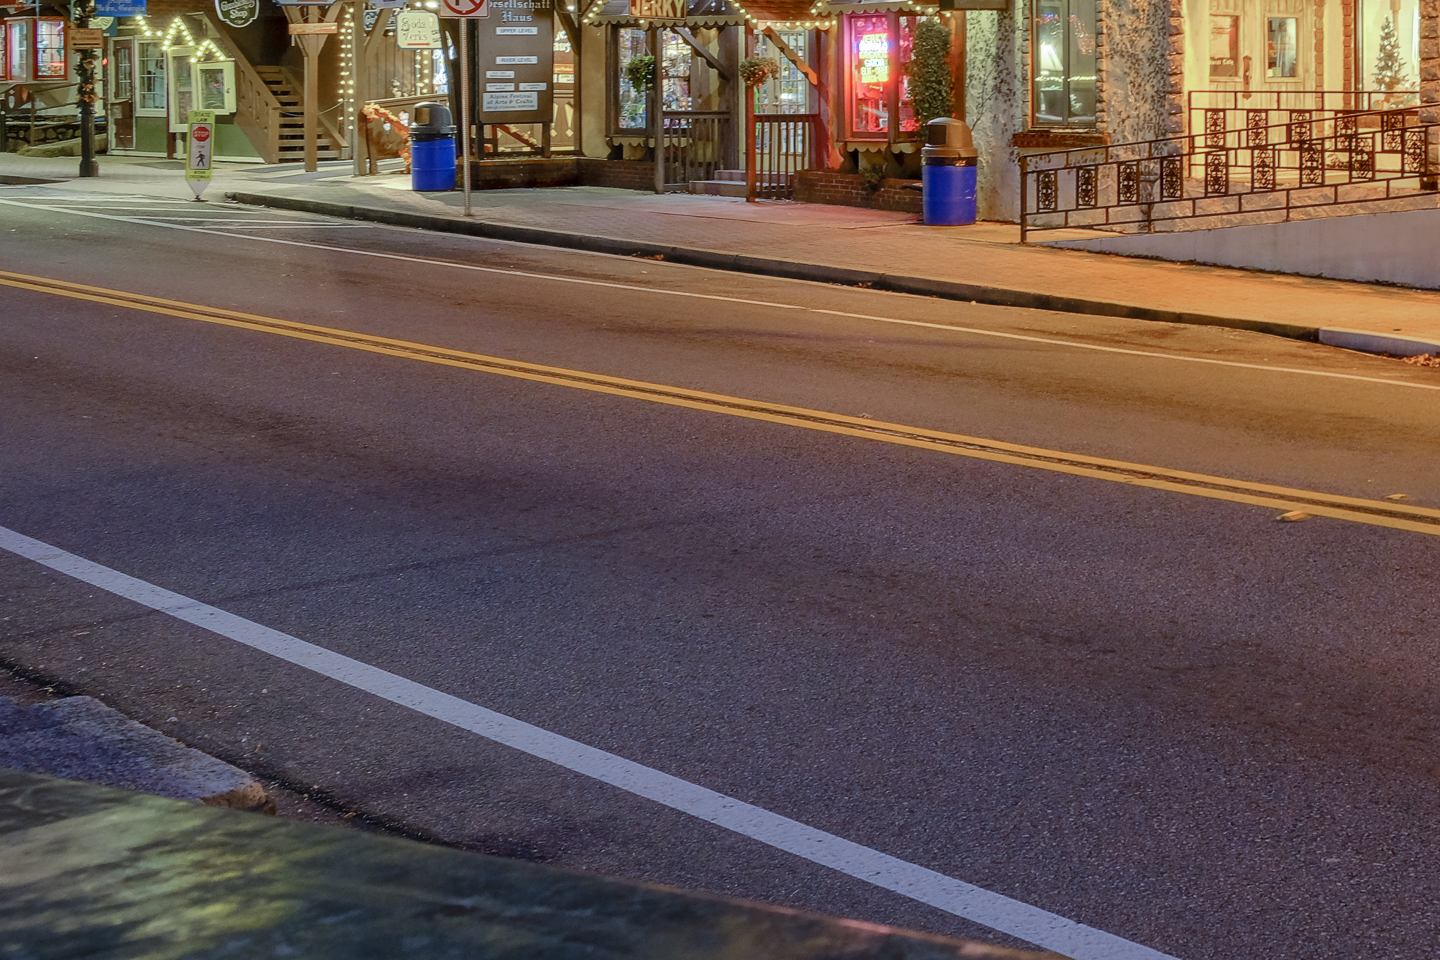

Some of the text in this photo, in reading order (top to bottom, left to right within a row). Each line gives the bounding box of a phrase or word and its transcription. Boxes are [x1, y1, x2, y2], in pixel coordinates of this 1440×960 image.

[229, 9, 248, 19] Shop
[501, 10, 533, 24] Haus
[401, 17, 426, 32] Soda
[193, 130, 209, 138] STOP
